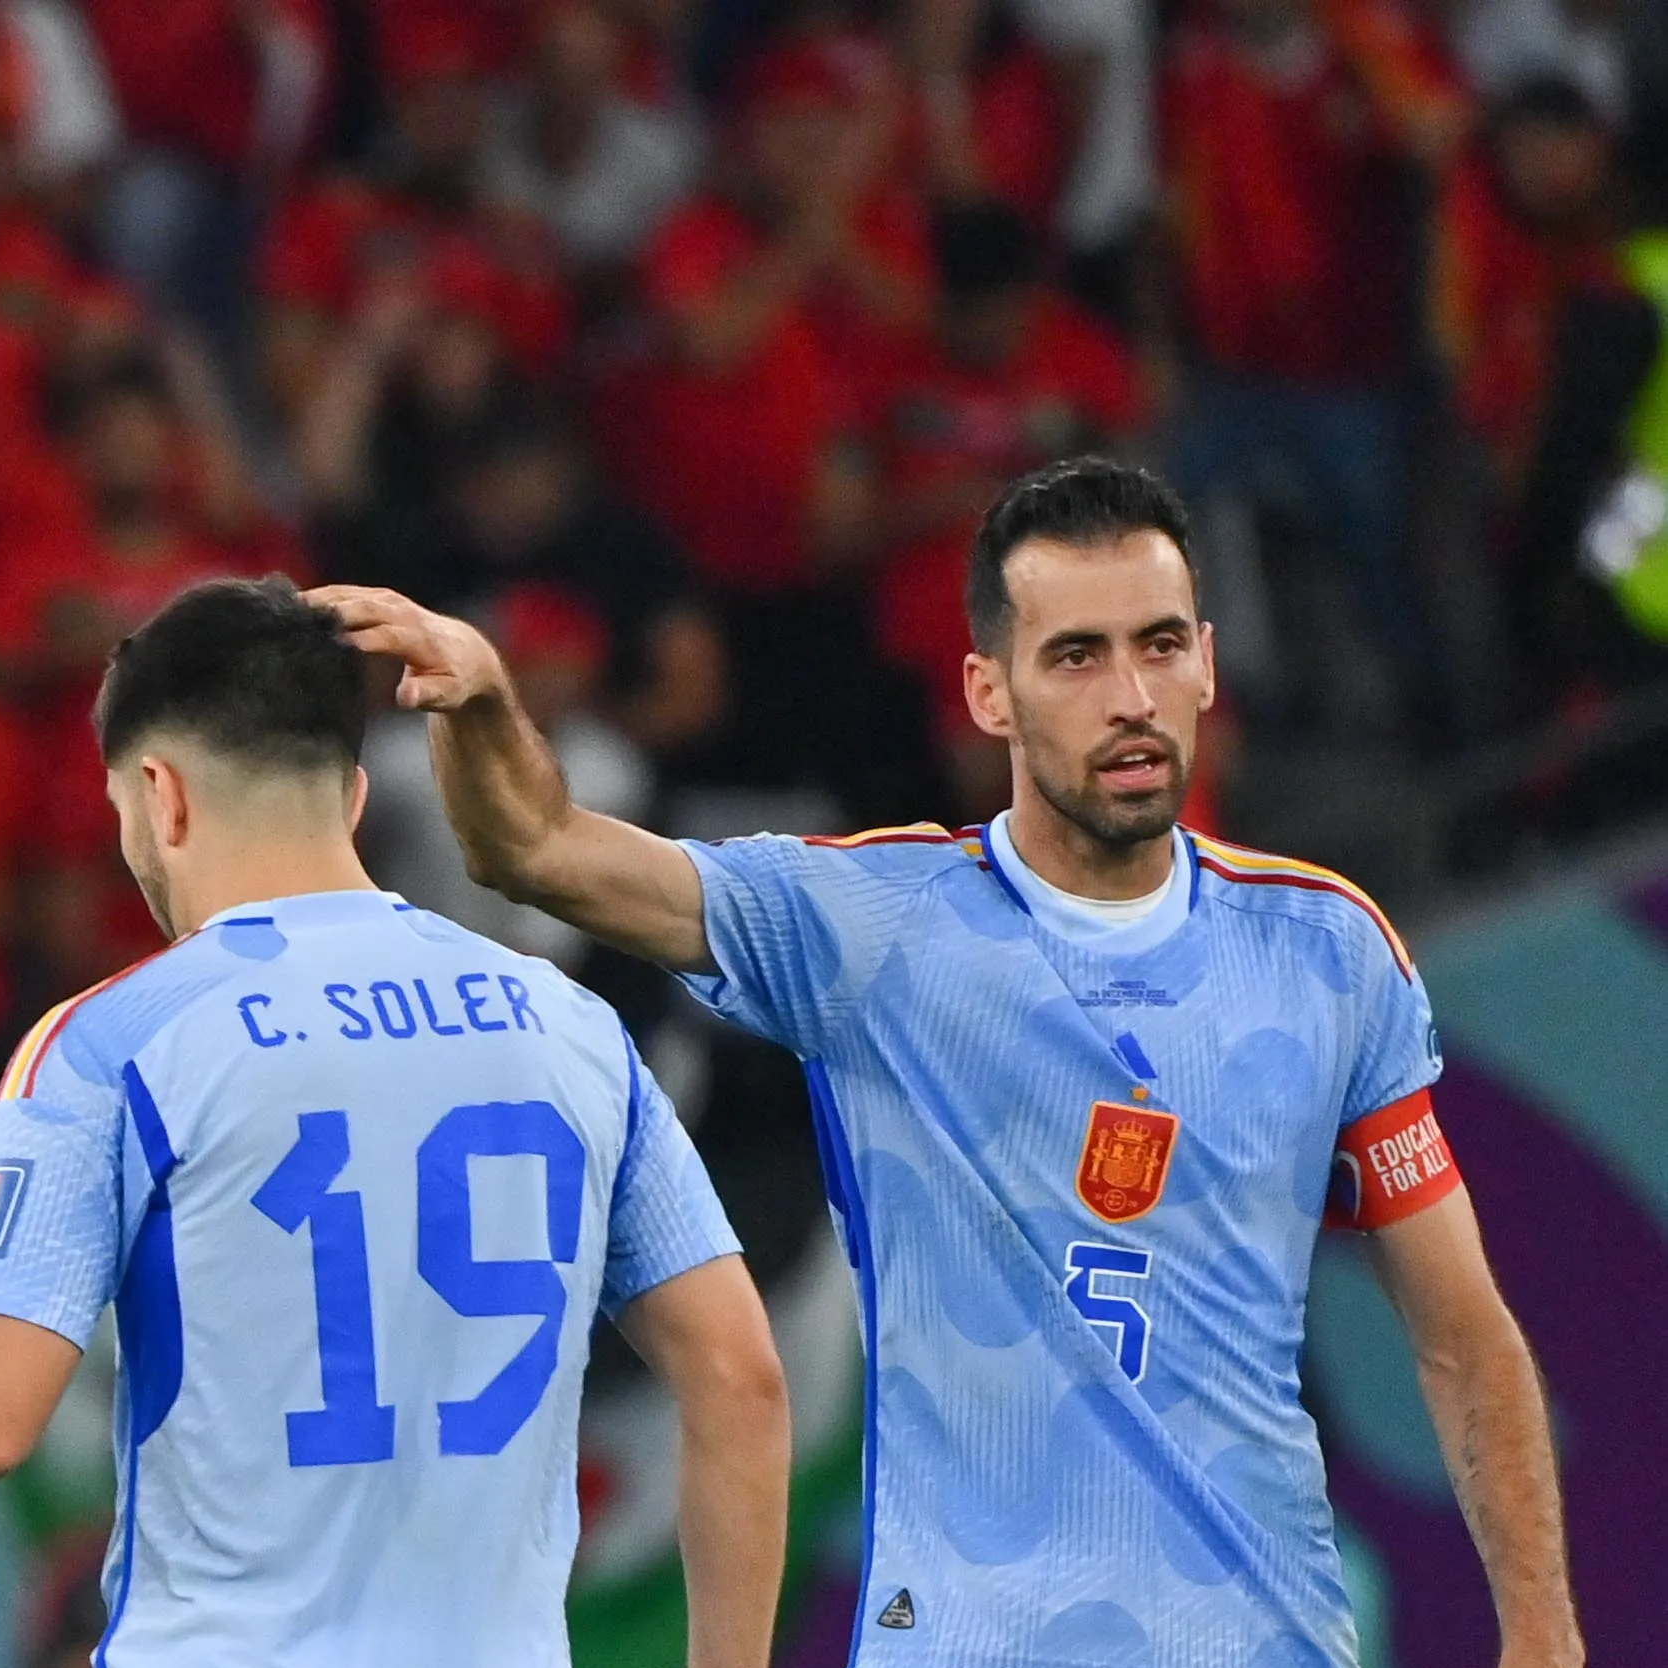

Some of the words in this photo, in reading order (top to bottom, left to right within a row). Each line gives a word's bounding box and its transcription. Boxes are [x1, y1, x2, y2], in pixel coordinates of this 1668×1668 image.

[236, 993, 308, 1048] C.
[323, 973, 546, 1041] SOLER
[1380, 1160, 1424, 1199] FOR
[1421, 1143, 1449, 1179] ALL
[251, 1100, 585, 1467] 19
